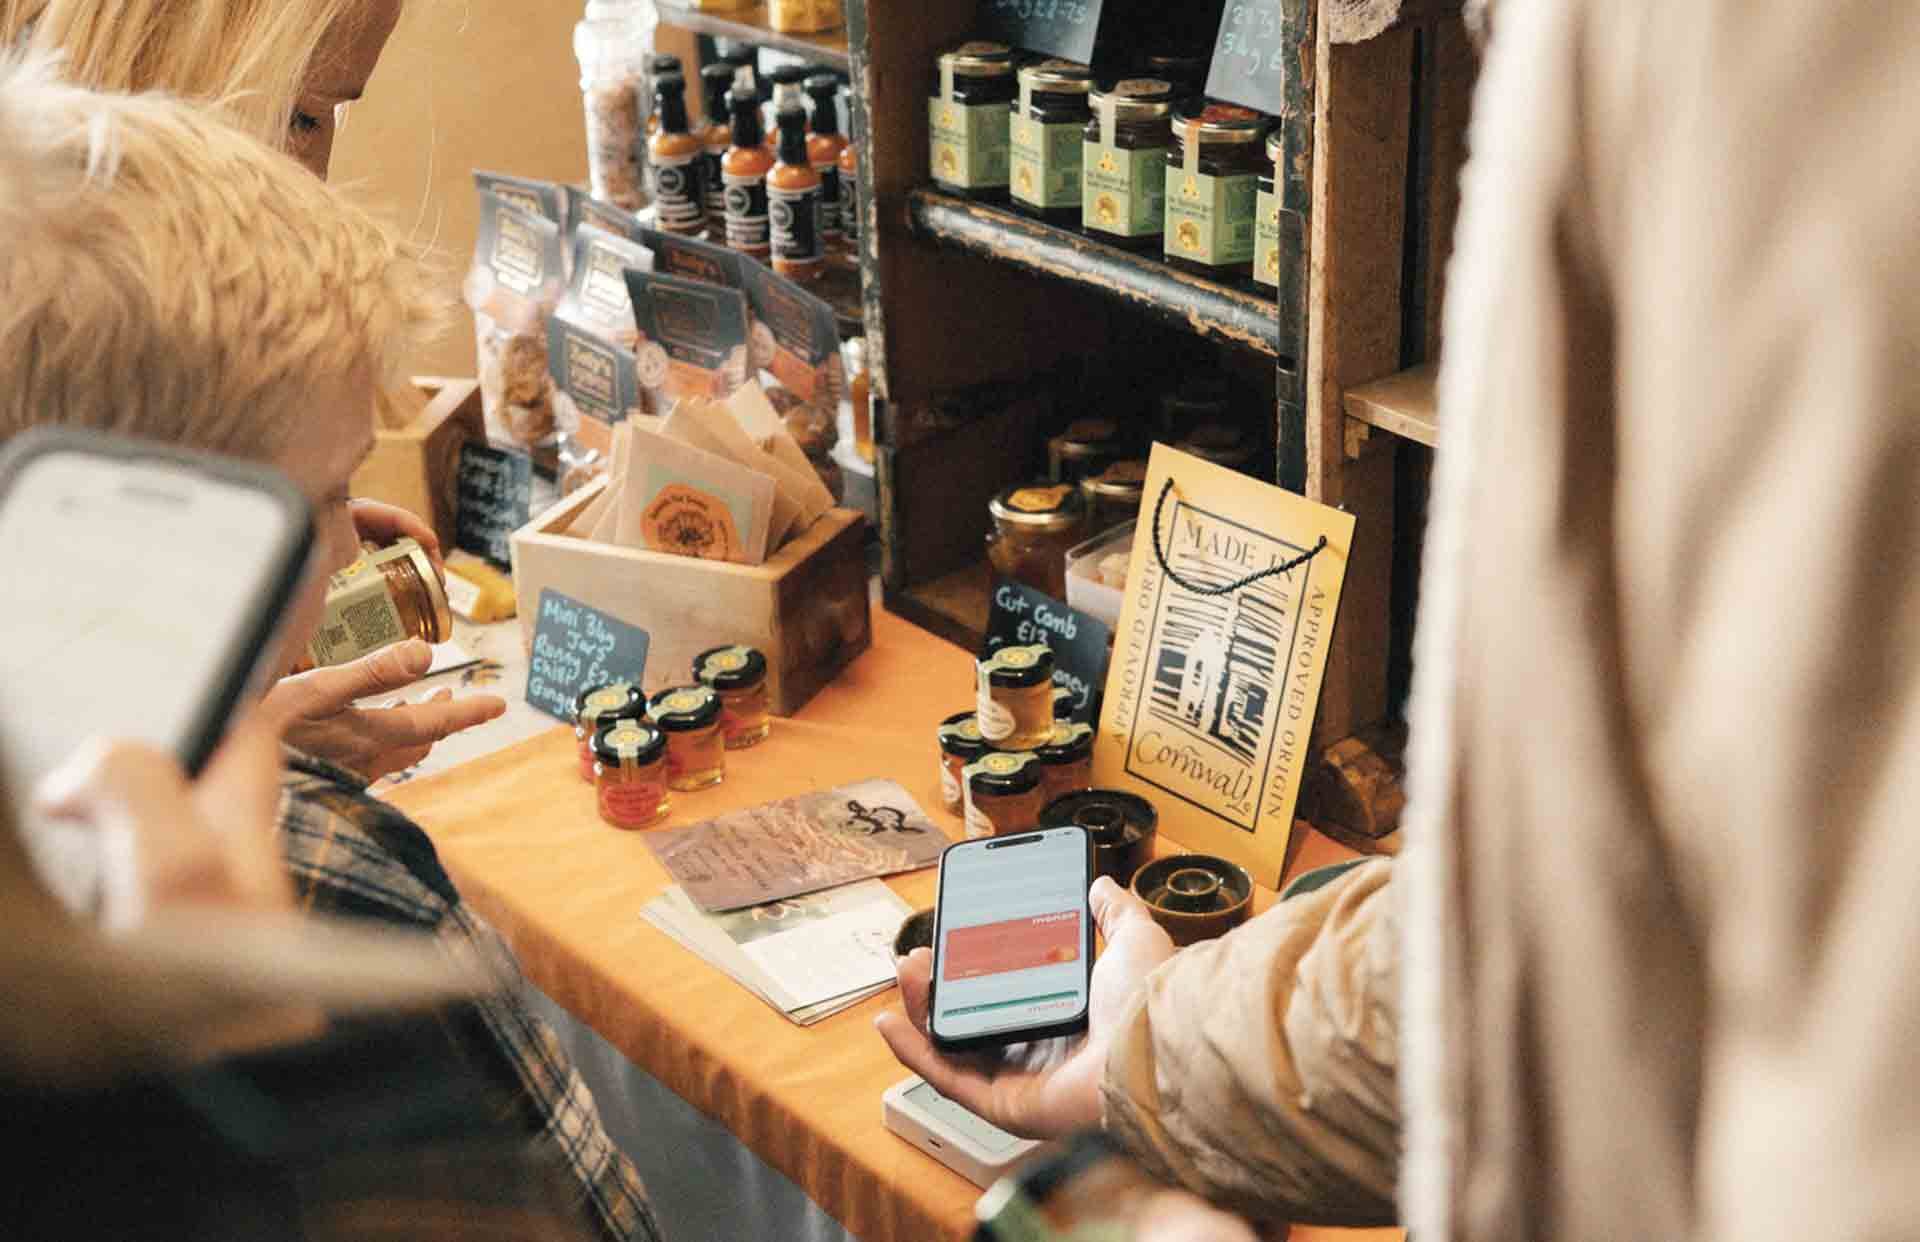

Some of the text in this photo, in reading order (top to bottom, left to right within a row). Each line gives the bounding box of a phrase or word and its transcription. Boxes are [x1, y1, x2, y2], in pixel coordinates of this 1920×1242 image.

[1182, 519, 1256, 569] MADE
[543, 599, 582, 628] Mini
[996, 585, 1078, 640] Cut Comb
[1112, 618, 1145, 748] APPROVED
[1288, 584, 1327, 720] APPROVED
[1052, 669, 1090, 709] oney
[1135, 730, 1254, 810] Cornwall
[1264, 731, 1296, 819] ORIGIN
